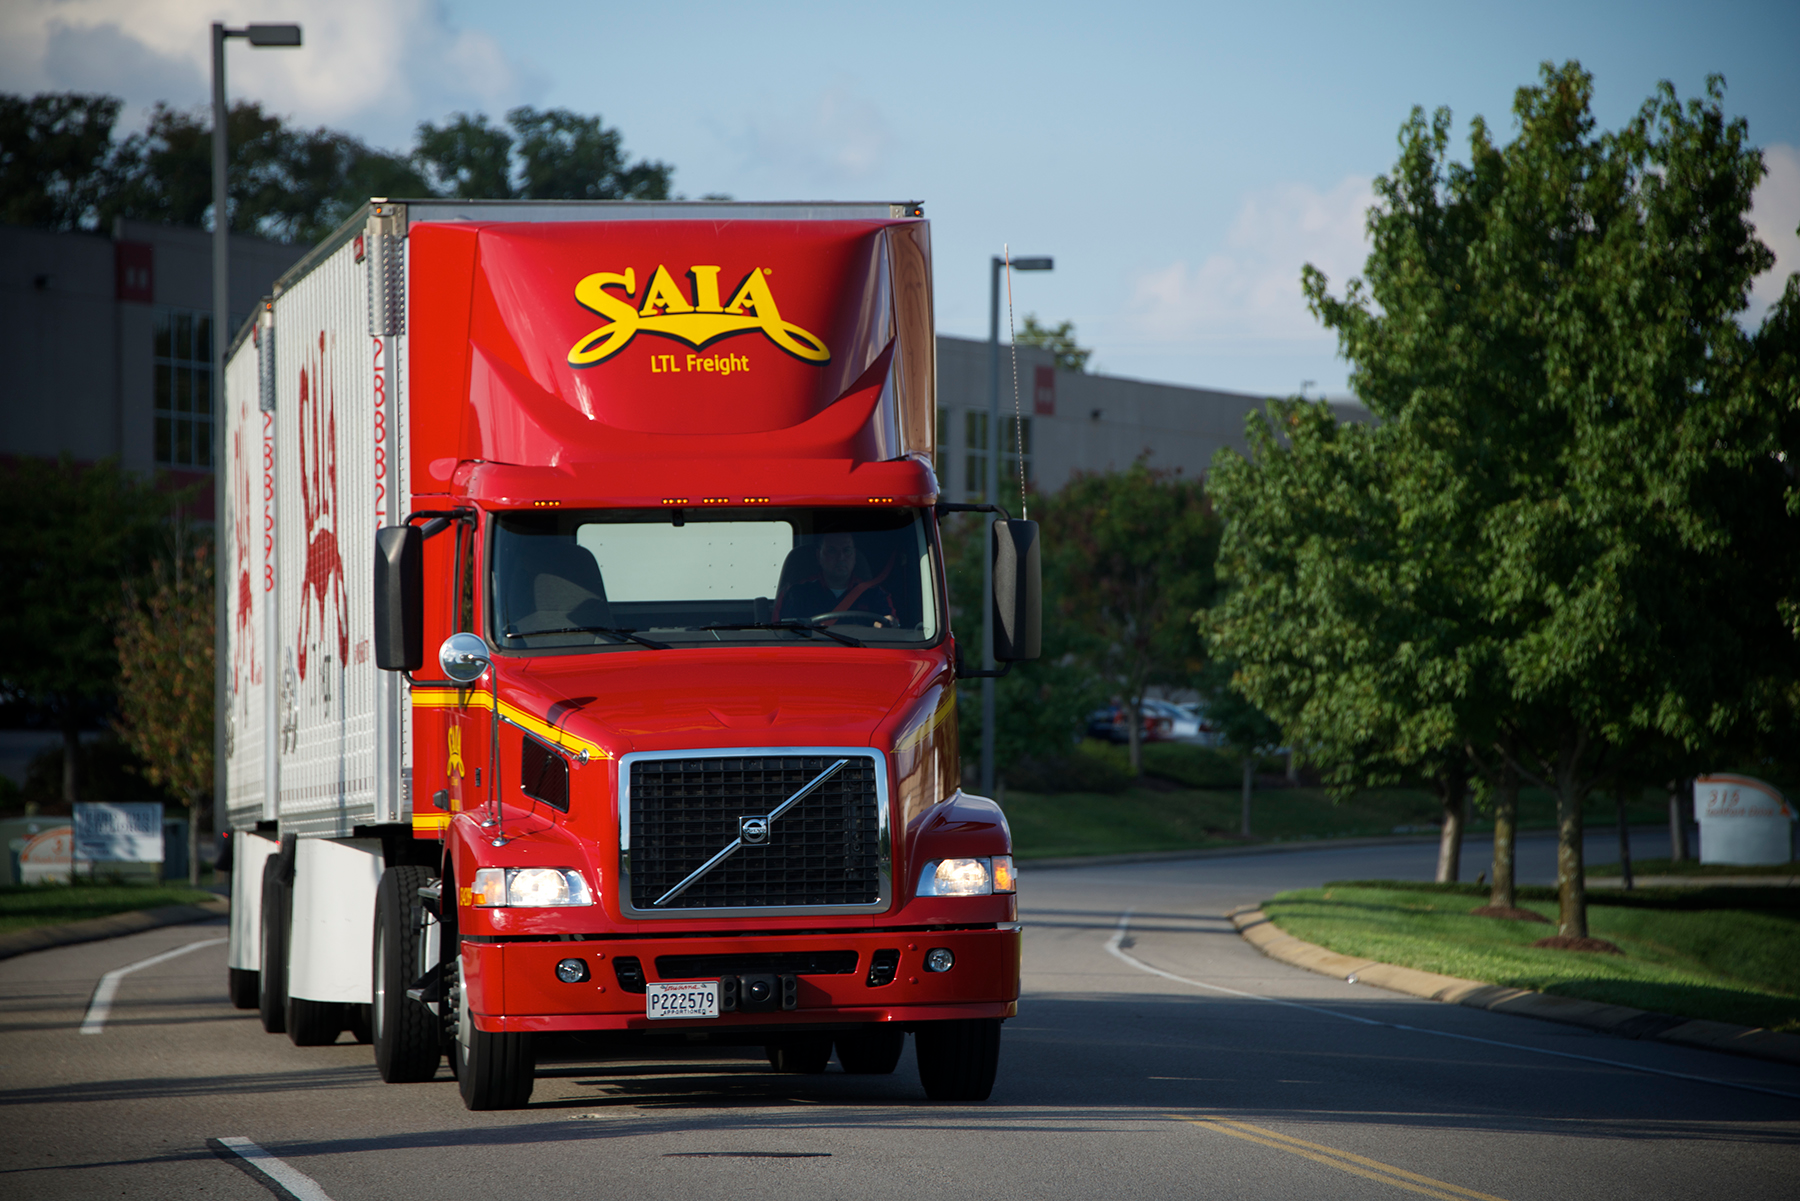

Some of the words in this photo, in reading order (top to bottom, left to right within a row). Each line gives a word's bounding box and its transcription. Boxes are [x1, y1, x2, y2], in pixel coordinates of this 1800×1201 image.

[567, 264, 831, 369] SAIA
[651, 355, 681, 373] LTL
[686, 353, 750, 376] Freight
[373, 338, 387, 530] 28882
[263, 412, 275, 592] 288698
[651, 992, 714, 1010] P222579
